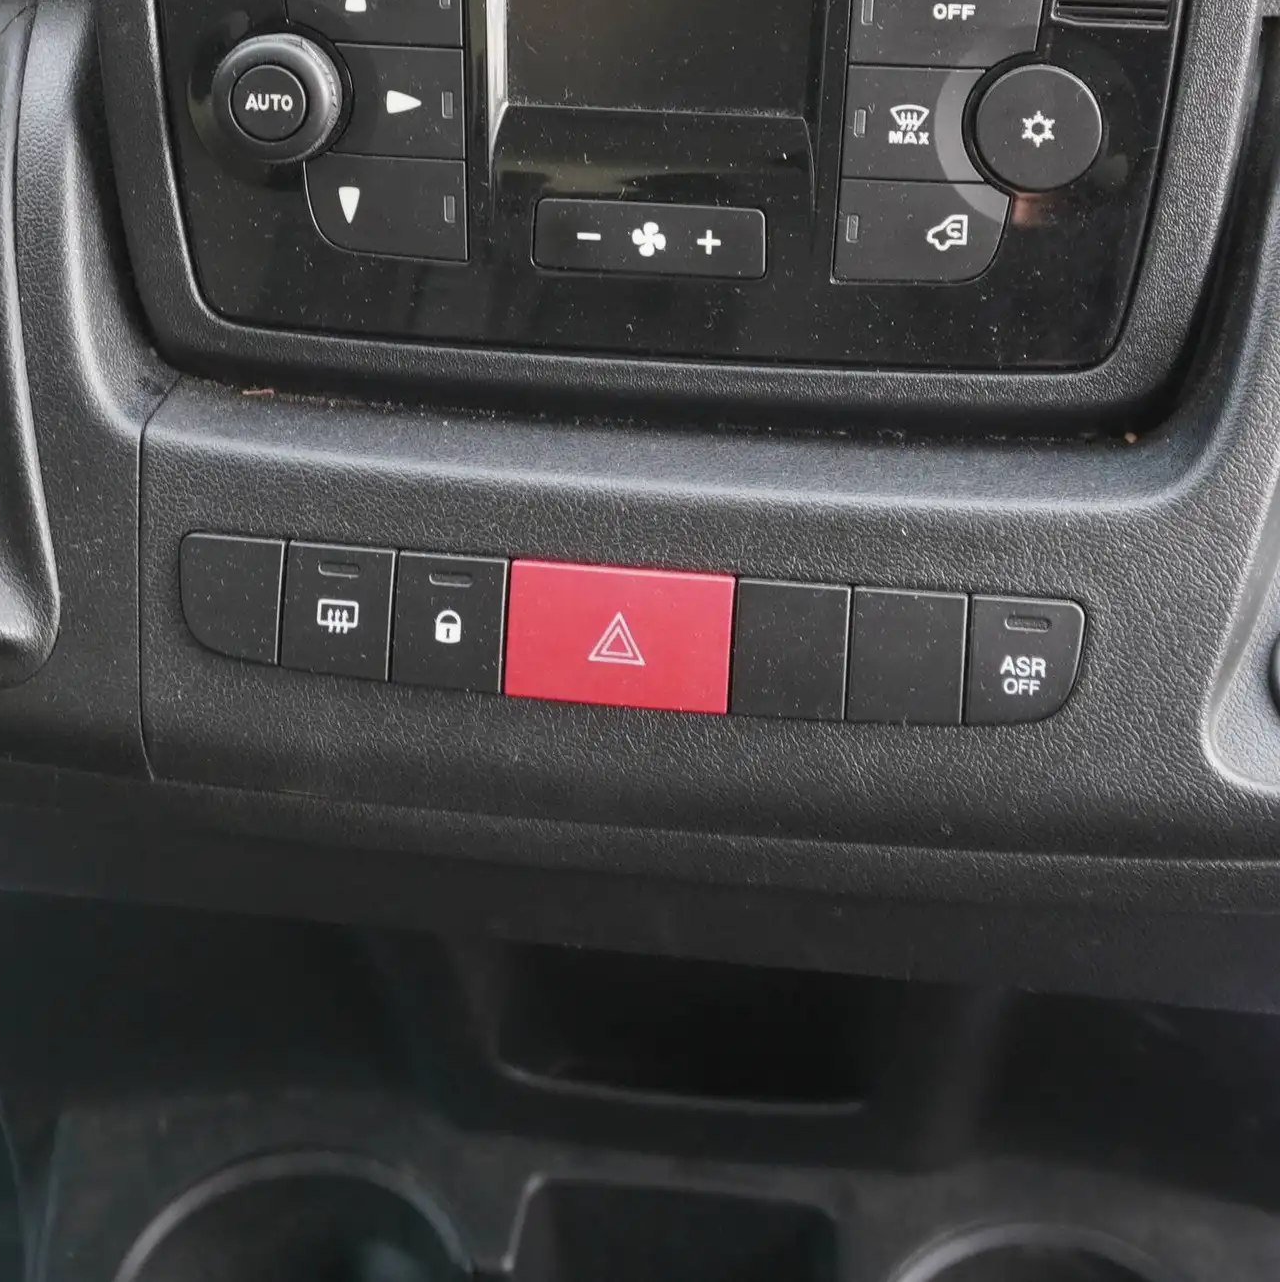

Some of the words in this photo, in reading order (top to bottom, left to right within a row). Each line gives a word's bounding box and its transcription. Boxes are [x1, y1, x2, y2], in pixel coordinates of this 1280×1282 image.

[933, 3, 976, 20] OFF
[245, 93, 293, 112] AUTO
[888, 130, 930, 145] MAX
[1000, 654, 1046, 678] ASR
[1003, 677, 1041, 696] OFF
